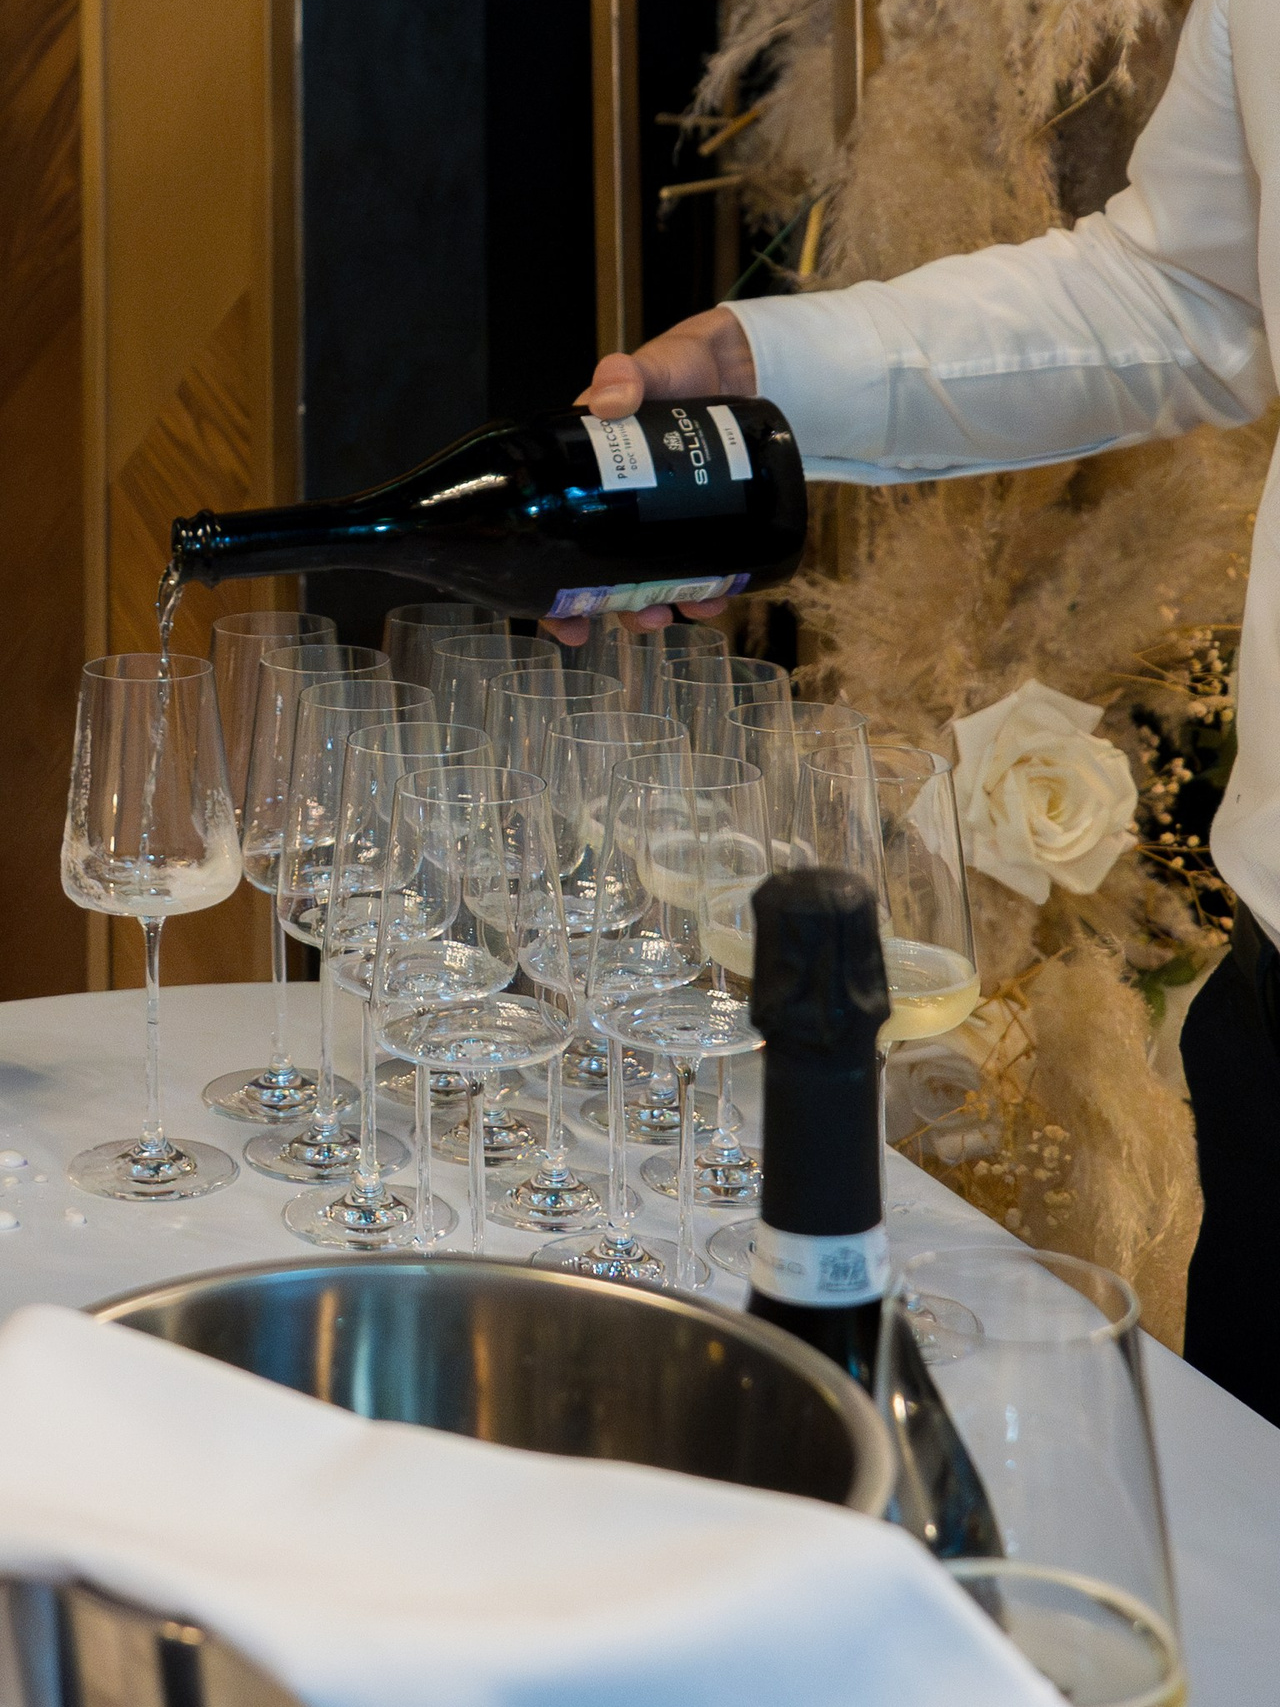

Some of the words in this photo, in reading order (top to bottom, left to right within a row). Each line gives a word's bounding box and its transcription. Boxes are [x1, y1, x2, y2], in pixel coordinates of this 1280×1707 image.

[600, 419, 628, 479] PROSECCO
[671, 407, 708, 486] SOLIGO
[724, 427, 737, 446] BRUT
